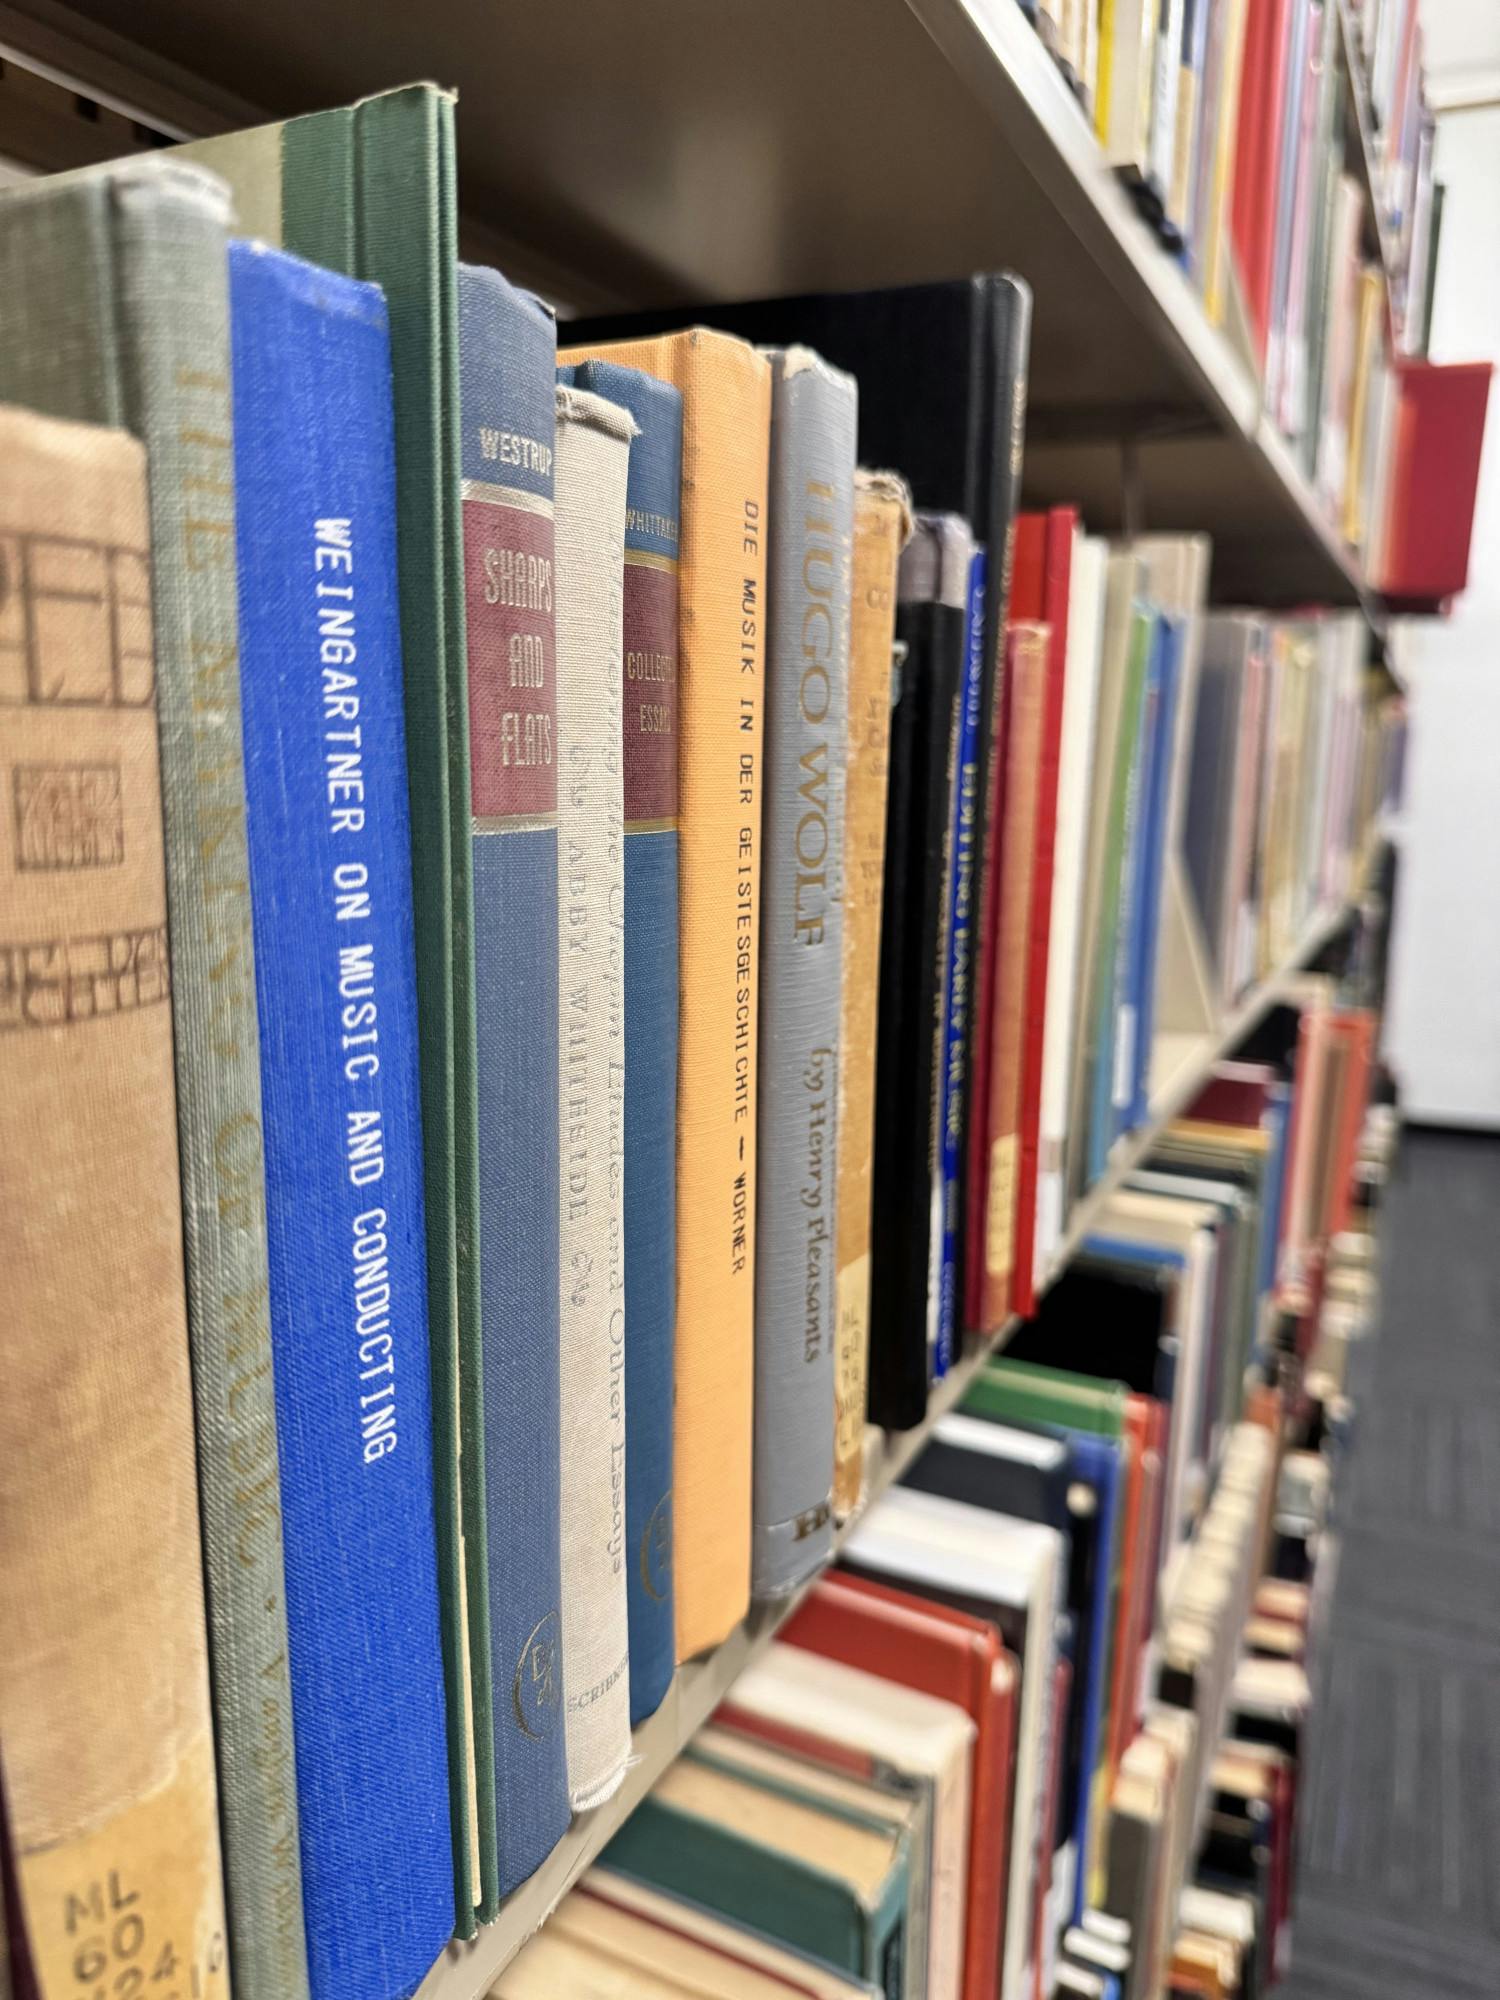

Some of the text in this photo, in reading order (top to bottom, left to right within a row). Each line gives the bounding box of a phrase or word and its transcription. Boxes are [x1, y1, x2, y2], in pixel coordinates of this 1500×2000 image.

[479, 427, 553, 477] WESTRUP
[741, 500, 760, 556] DIE
[484, 547, 553, 613] SHARPS
[509, 632, 544, 688] AND
[739, 579, 757, 675] MUSIK
[500, 712, 552, 766] FLATS
[738, 699, 755, 732] IN
[795, 480, 834, 946] HUGO WOLF
[739, 754, 755, 804] DER
[312, 517, 398, 1464] WEINGARTNER ON MUSIC AND CONDUCTING
[733, 827, 755, 1124] GEISTESGESCHICHTE
[730, 1172, 748, 1276] WORNER
[801, 1048, 832, 1364] by Henry Pleasants
[608, 1306, 627, 1430] Other
[606, 1442, 625, 1575] Essays
[64, 1868, 140, 1937] ML
[73, 1913, 144, 1982] 60
